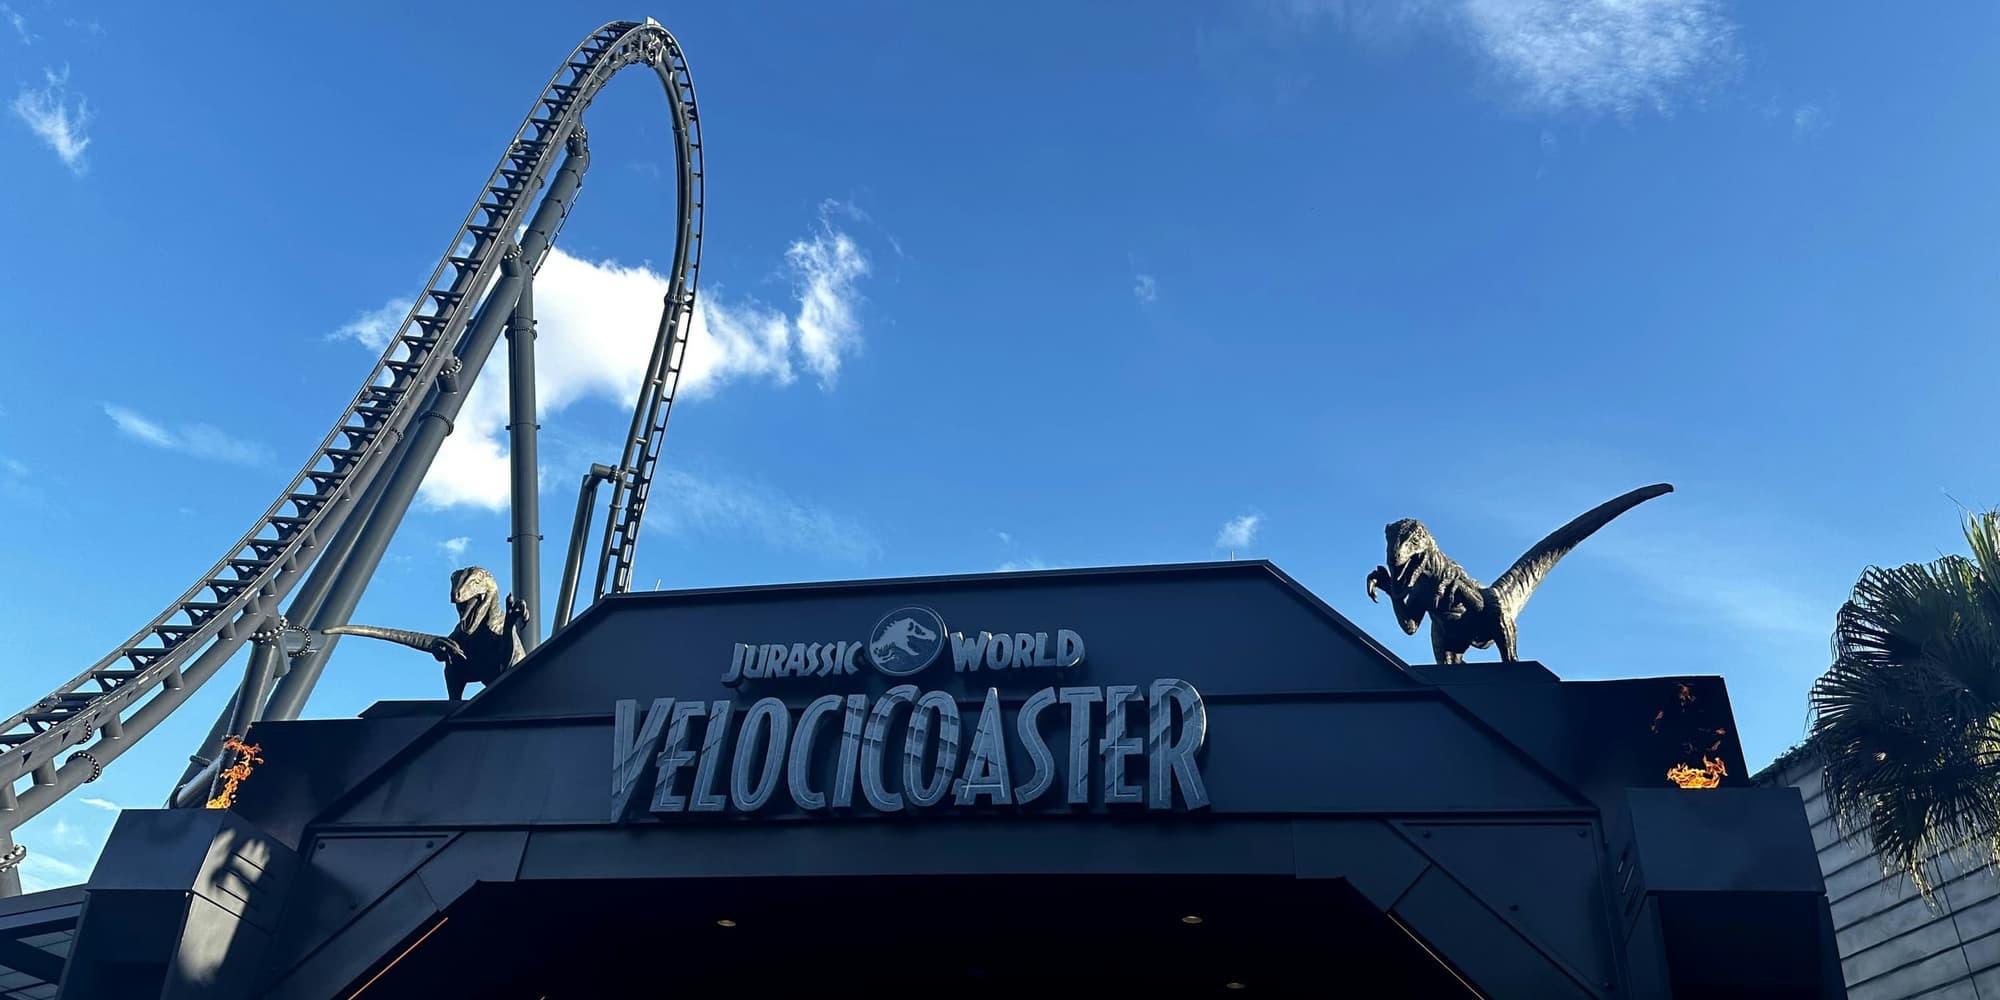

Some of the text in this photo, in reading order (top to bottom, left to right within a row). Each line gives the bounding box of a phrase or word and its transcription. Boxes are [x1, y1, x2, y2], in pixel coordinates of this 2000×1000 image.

[723, 629, 1085, 685] JURASSIC WORLD
[612, 677, 1210, 821] VELOCICOASTER
